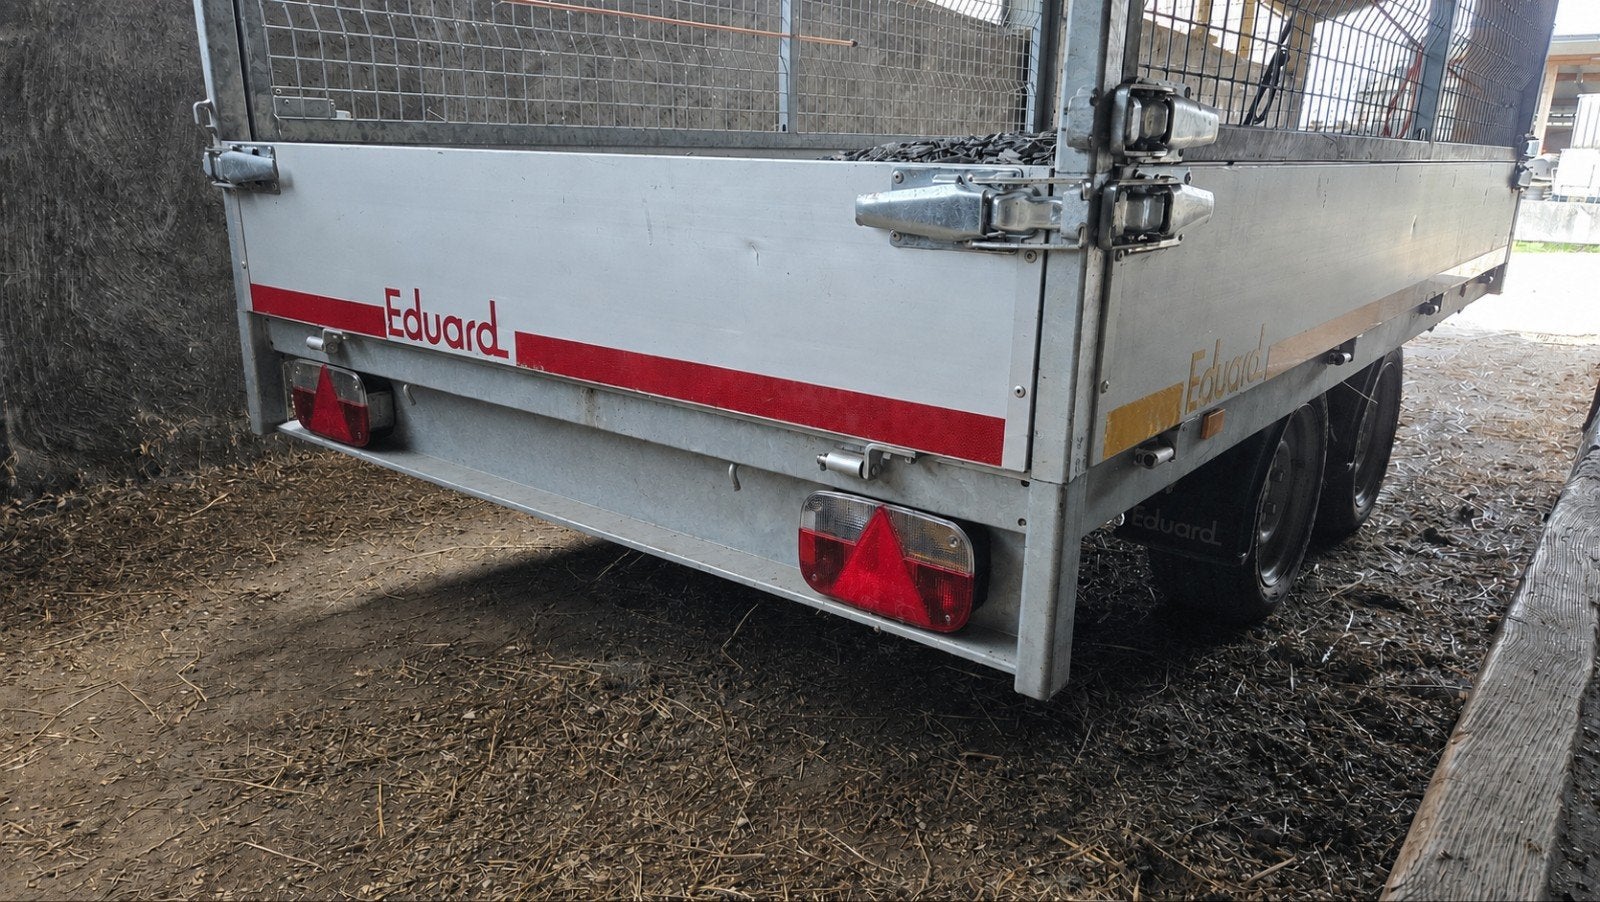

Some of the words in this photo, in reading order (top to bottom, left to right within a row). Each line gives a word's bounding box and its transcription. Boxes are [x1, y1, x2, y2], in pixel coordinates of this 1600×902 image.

[385, 287, 509, 359] Eduard
[1185, 324, 1266, 415] Eduard
[1131, 505, 1222, 546] Eduard
